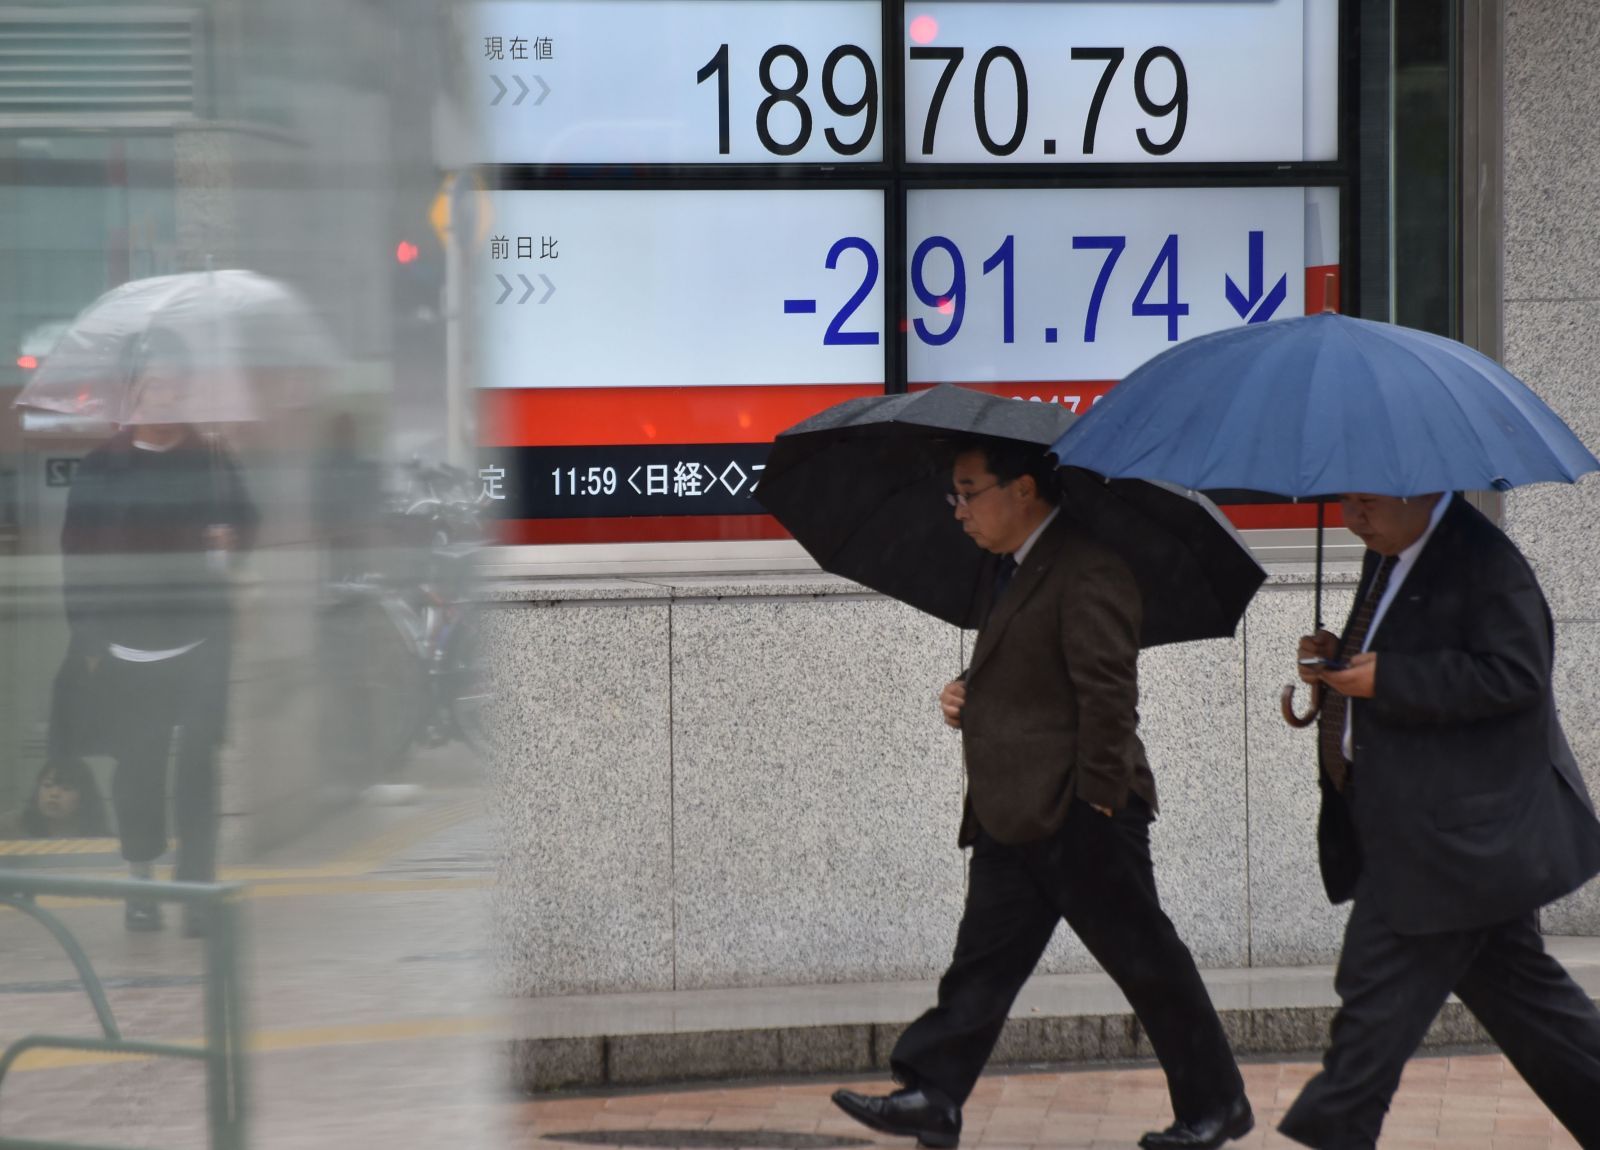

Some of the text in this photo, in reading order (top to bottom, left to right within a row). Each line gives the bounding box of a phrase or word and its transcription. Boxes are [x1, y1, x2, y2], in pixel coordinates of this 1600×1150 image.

[484, 35, 554, 61] 現在値
[696, 44, 1189, 156] 18970.79
[490, 234, 560, 260] 前日比
[784, 234, 1189, 346] -291.74
[474, 464, 506, 503] 定
[551, 466, 617, 496] 11:59
